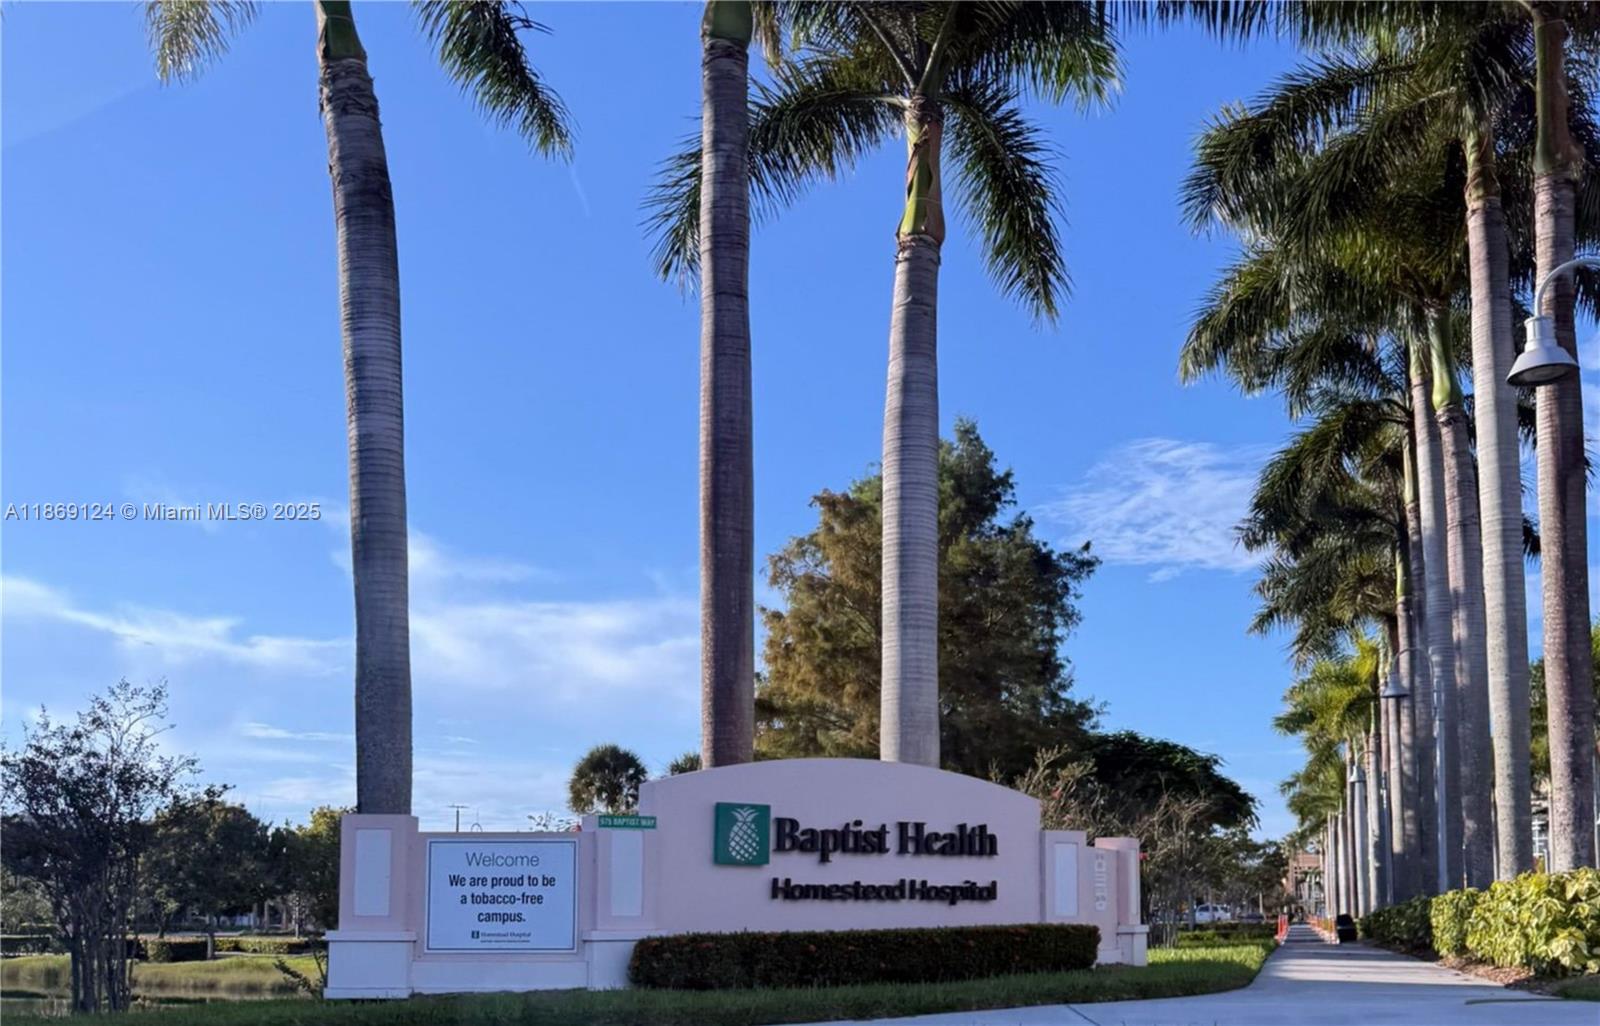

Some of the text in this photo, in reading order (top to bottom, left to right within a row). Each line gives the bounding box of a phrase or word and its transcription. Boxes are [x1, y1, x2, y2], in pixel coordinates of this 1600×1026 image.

[613, 817, 640, 826] BAPTIST
[641, 818, 655, 827] WAY
[773, 817, 999, 865] Baptist Health
[465, 852, 540, 867] Welcome
[448, 874, 556, 889] We are proud to be
[460, 892, 543, 904] a tobacco-free
[770, 877, 998, 906] Homestead Hospital
[477, 912, 526, 925] campus.
